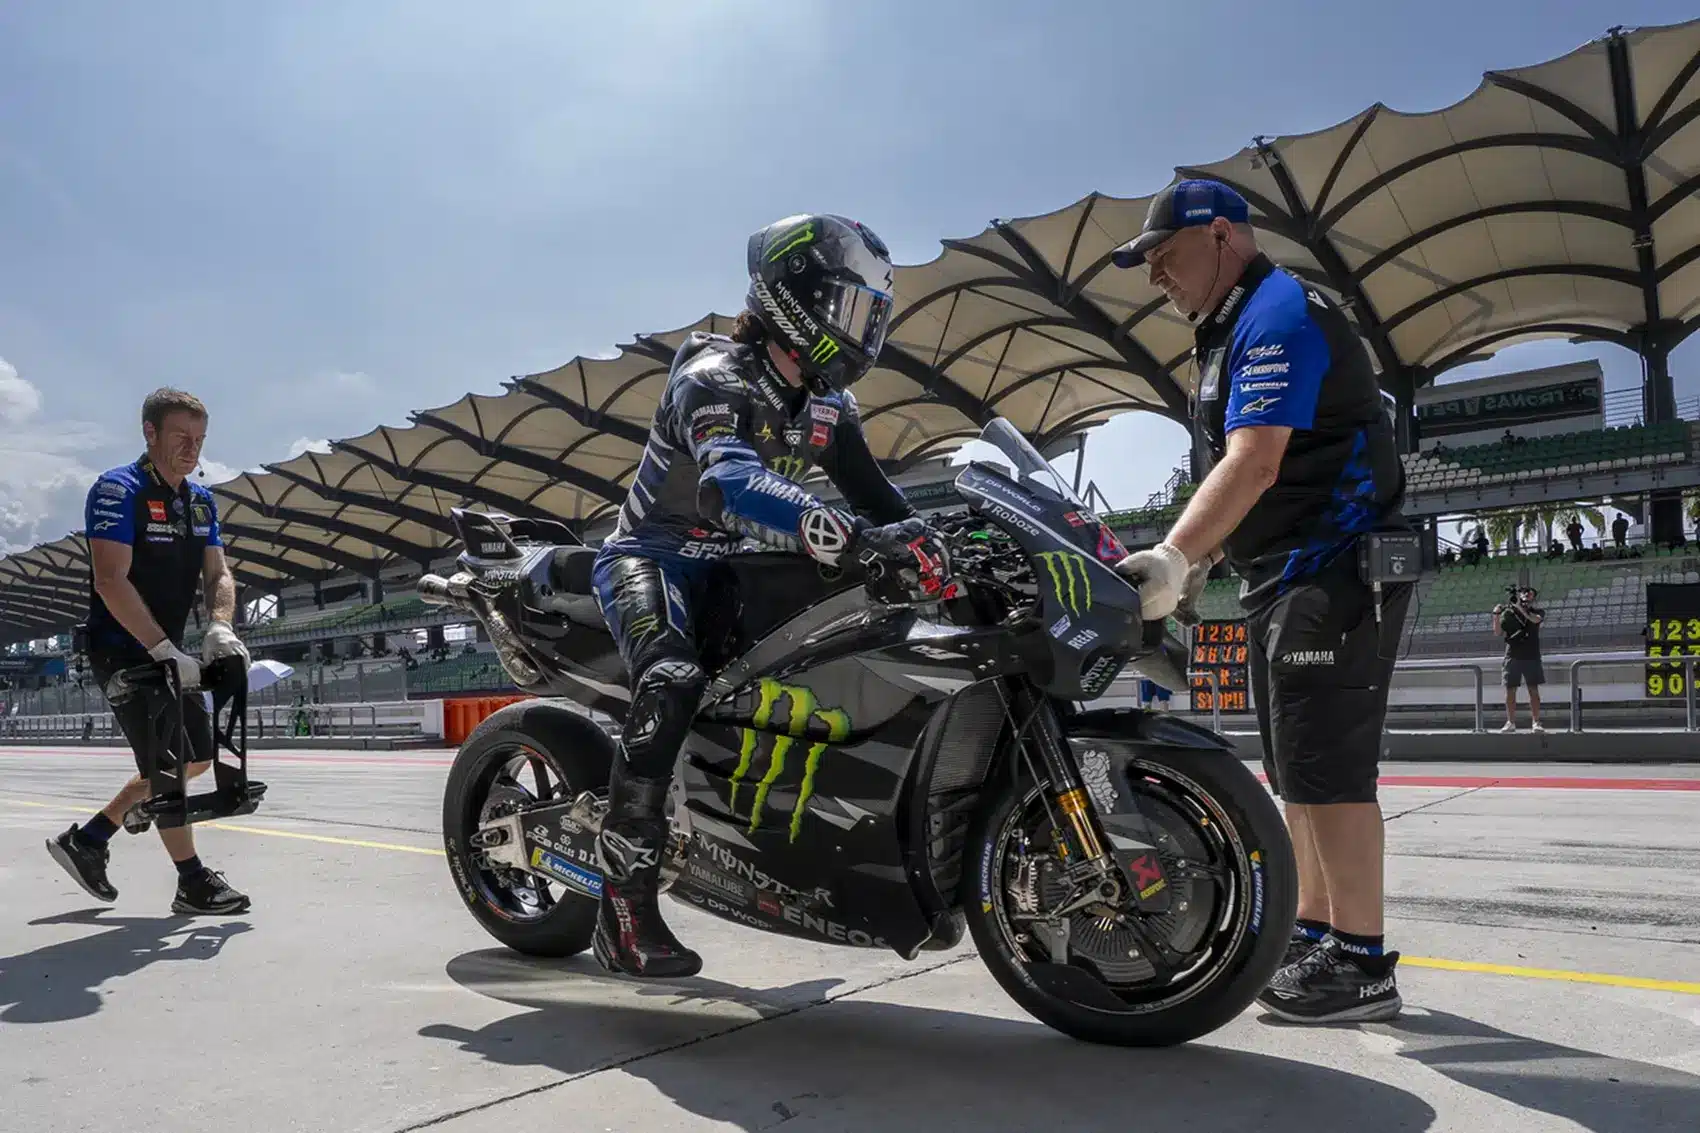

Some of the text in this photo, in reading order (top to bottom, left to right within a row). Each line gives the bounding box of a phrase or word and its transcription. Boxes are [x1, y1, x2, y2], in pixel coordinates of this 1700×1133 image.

[775, 281, 819, 335] MONSTER
[1223, 286, 1245, 320] YAMAHA
[757, 375, 784, 411] YAMAHA
[985, 479, 1042, 513] DP WORLD
[991, 502, 1040, 537] Roboze
[1291, 650, 1335, 662] YAMAHA
[552, 863, 602, 890] MICHELIN
[689, 862, 745, 897] YAMALUBE
[983, 842, 993, 892] MICHELIN
[1254, 871, 1263, 927] MICHELIN
[783, 905, 887, 947] ENEOS
[1360, 976, 1395, 999] HOKA
